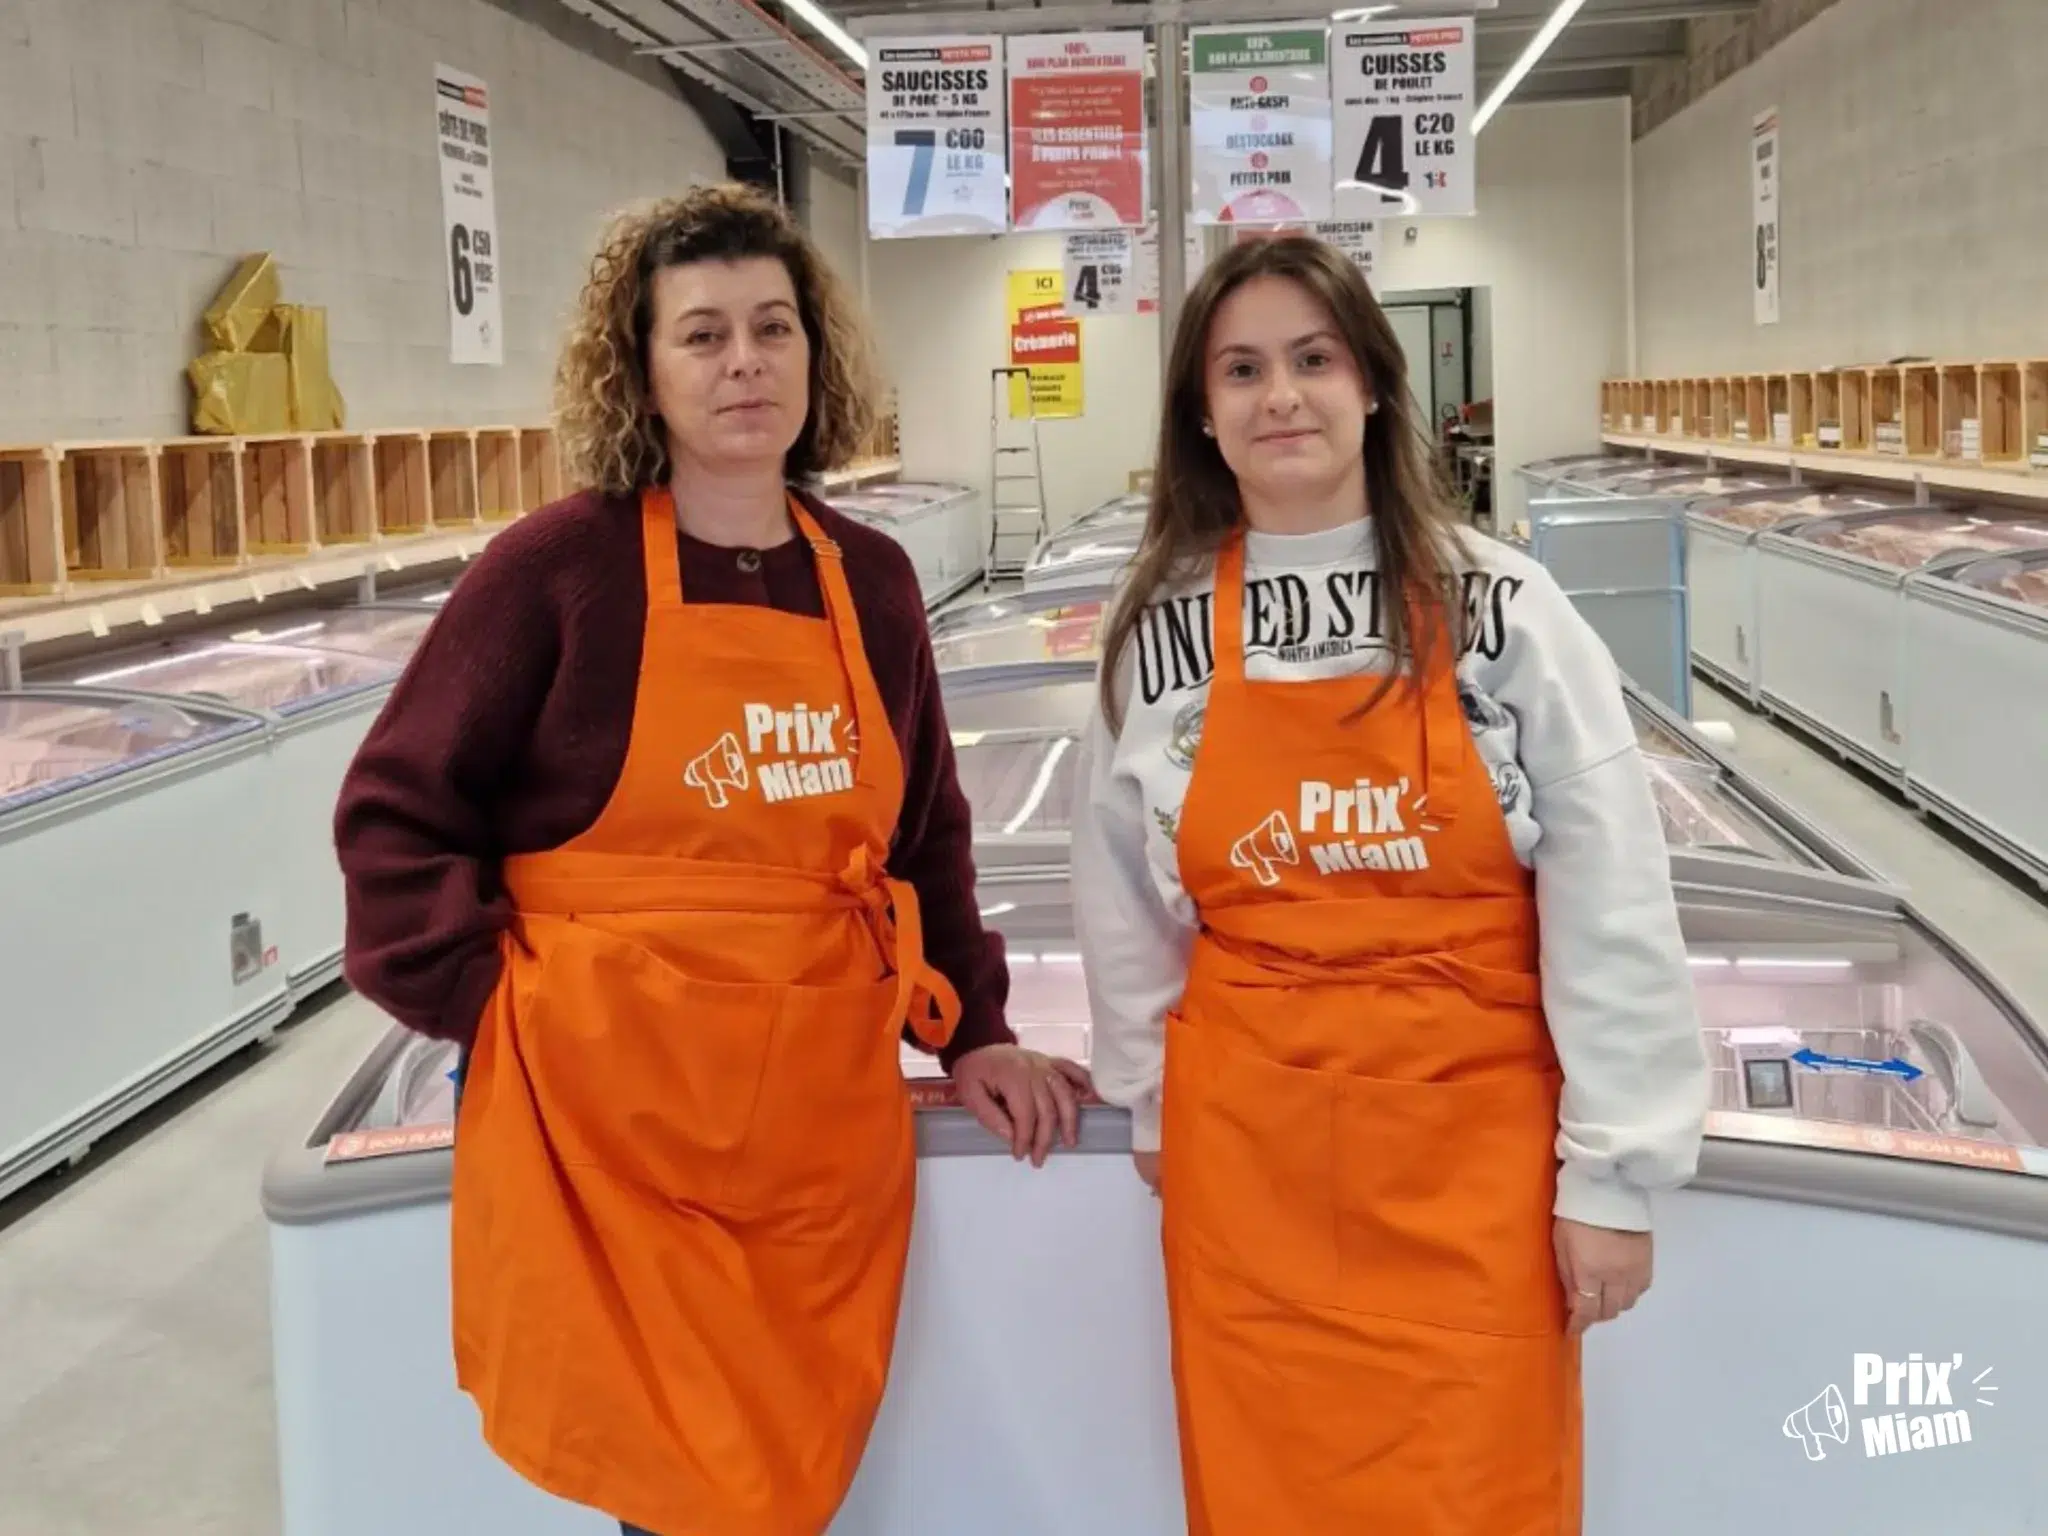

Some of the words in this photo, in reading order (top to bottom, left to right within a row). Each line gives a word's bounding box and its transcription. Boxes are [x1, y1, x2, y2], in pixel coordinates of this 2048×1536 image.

[882, 69, 989, 92] SAUCISSES
[1361, 51, 1447, 76] CUISSES
[1374, 77, 1388, 91] DE
[1391, 76, 1433, 90] POULET
[908, 93, 938, 106] PORC
[1354, 113, 1410, 204] 4
[1415, 140, 1430, 157] LE
[1433, 139, 1455, 156] KG
[894, 129, 936, 216] 7
[1230, 171, 1265, 187] PETITS
[452, 223, 474, 316] 6
[1036, 276, 1054, 290] ICI
[1074, 265, 1102, 309] 4
[1136, 573, 1311, 705] UNIED
[1327, 569, 1523, 662] STES
[743, 702, 841, 754] Prix'
[756, 757, 854, 804] Miam
[1300, 776, 1410, 835] Prix'
[1308, 835, 1431, 877] Miam
